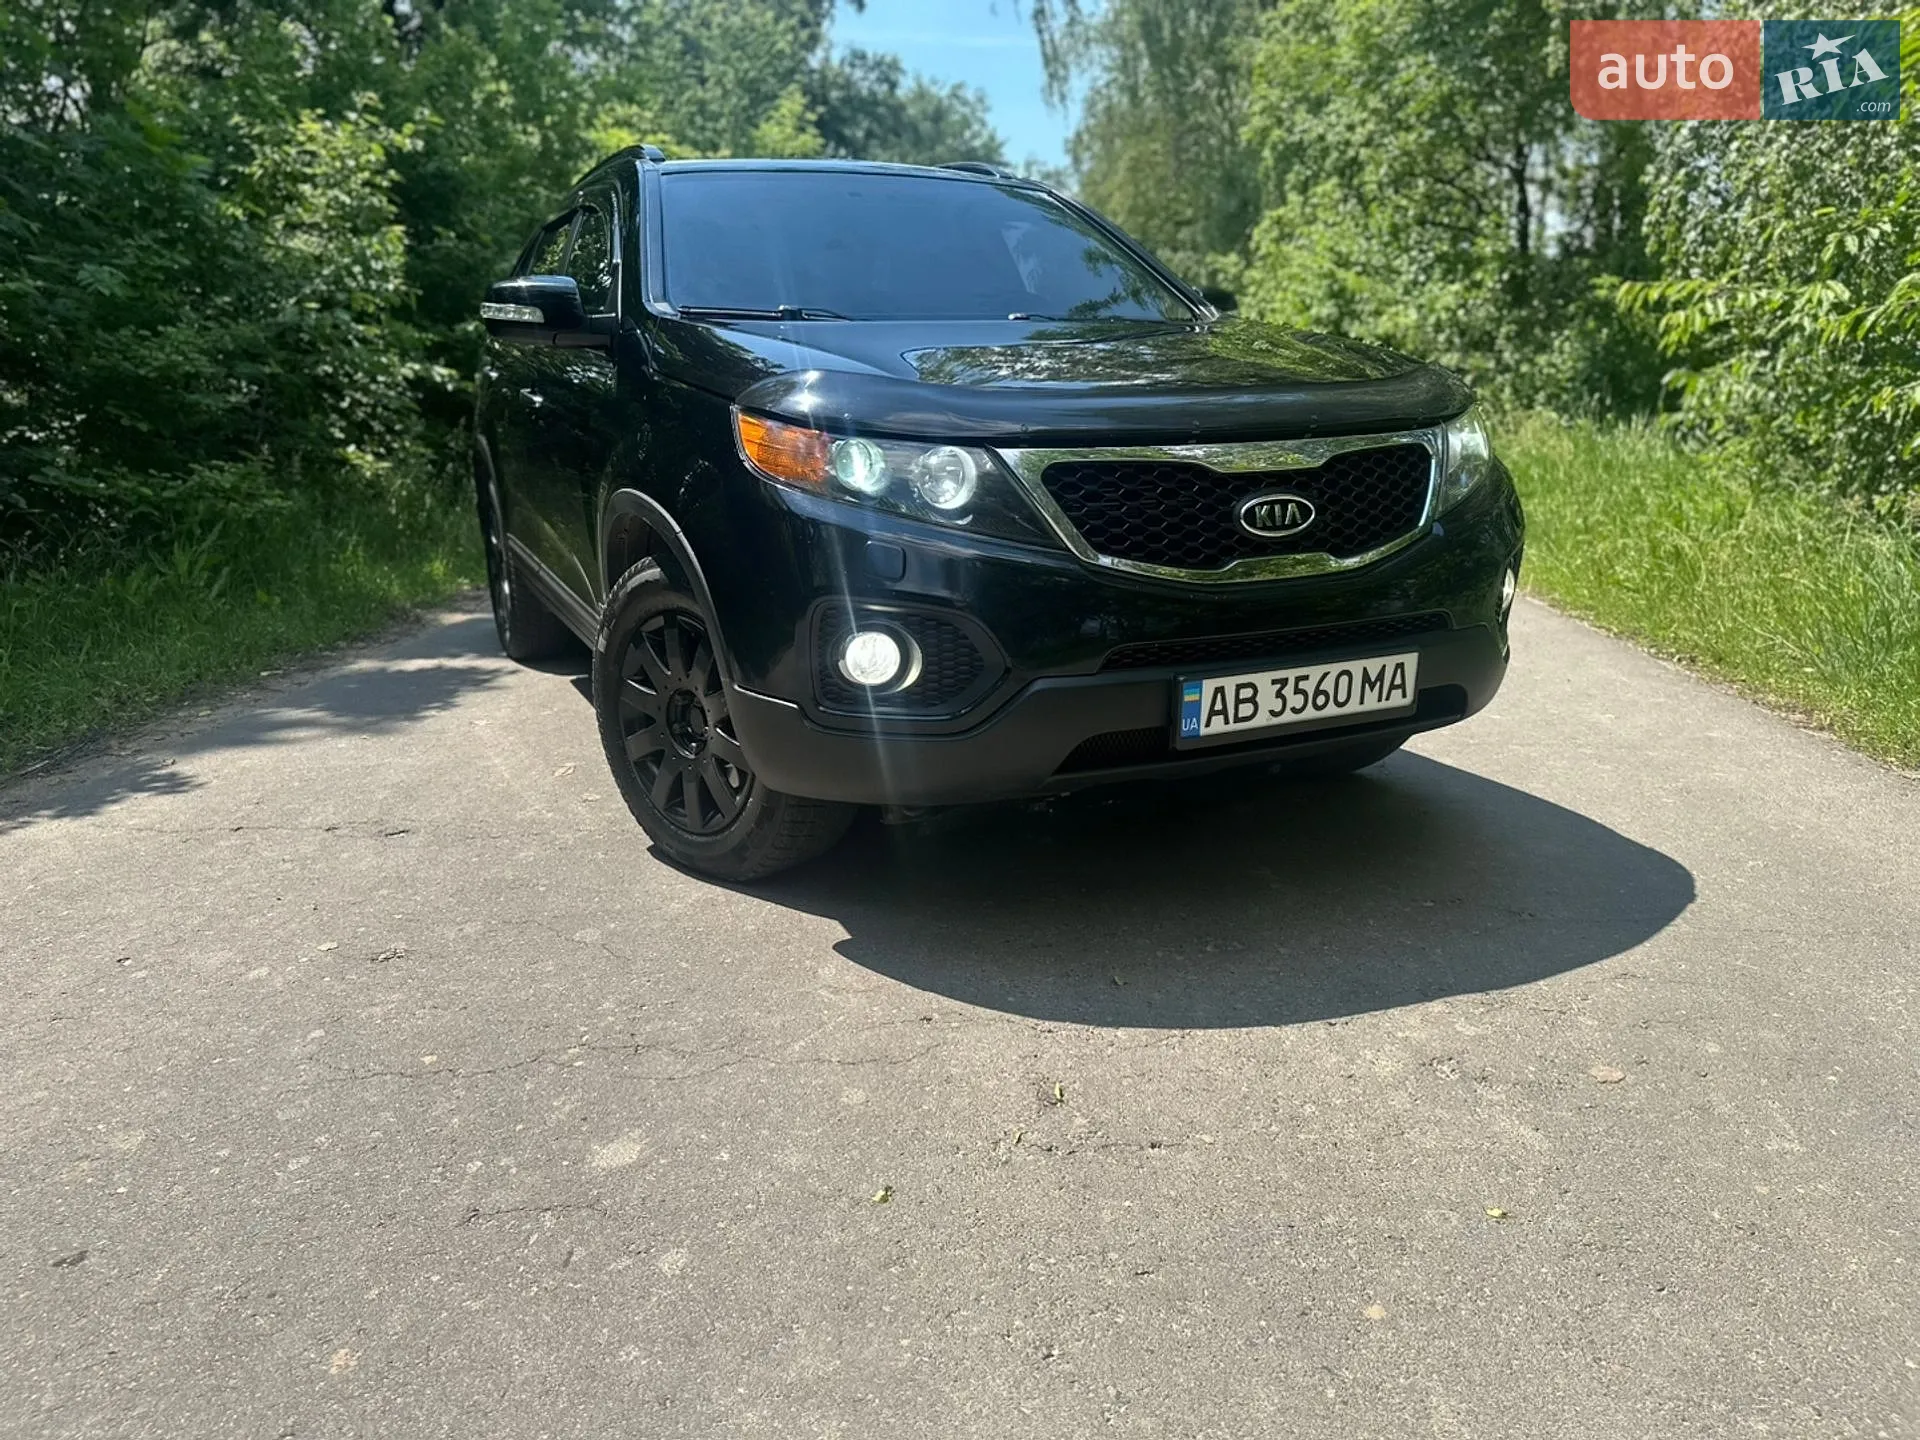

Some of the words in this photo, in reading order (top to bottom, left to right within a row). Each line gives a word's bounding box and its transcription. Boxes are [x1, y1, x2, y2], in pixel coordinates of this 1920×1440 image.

[1255, 503, 1301, 527] KIA
[1204, 682, 1259, 728] AB
[1268, 669, 1354, 719] 3560
[1359, 661, 1408, 706] MA
[1182, 717, 1199, 732] UA
